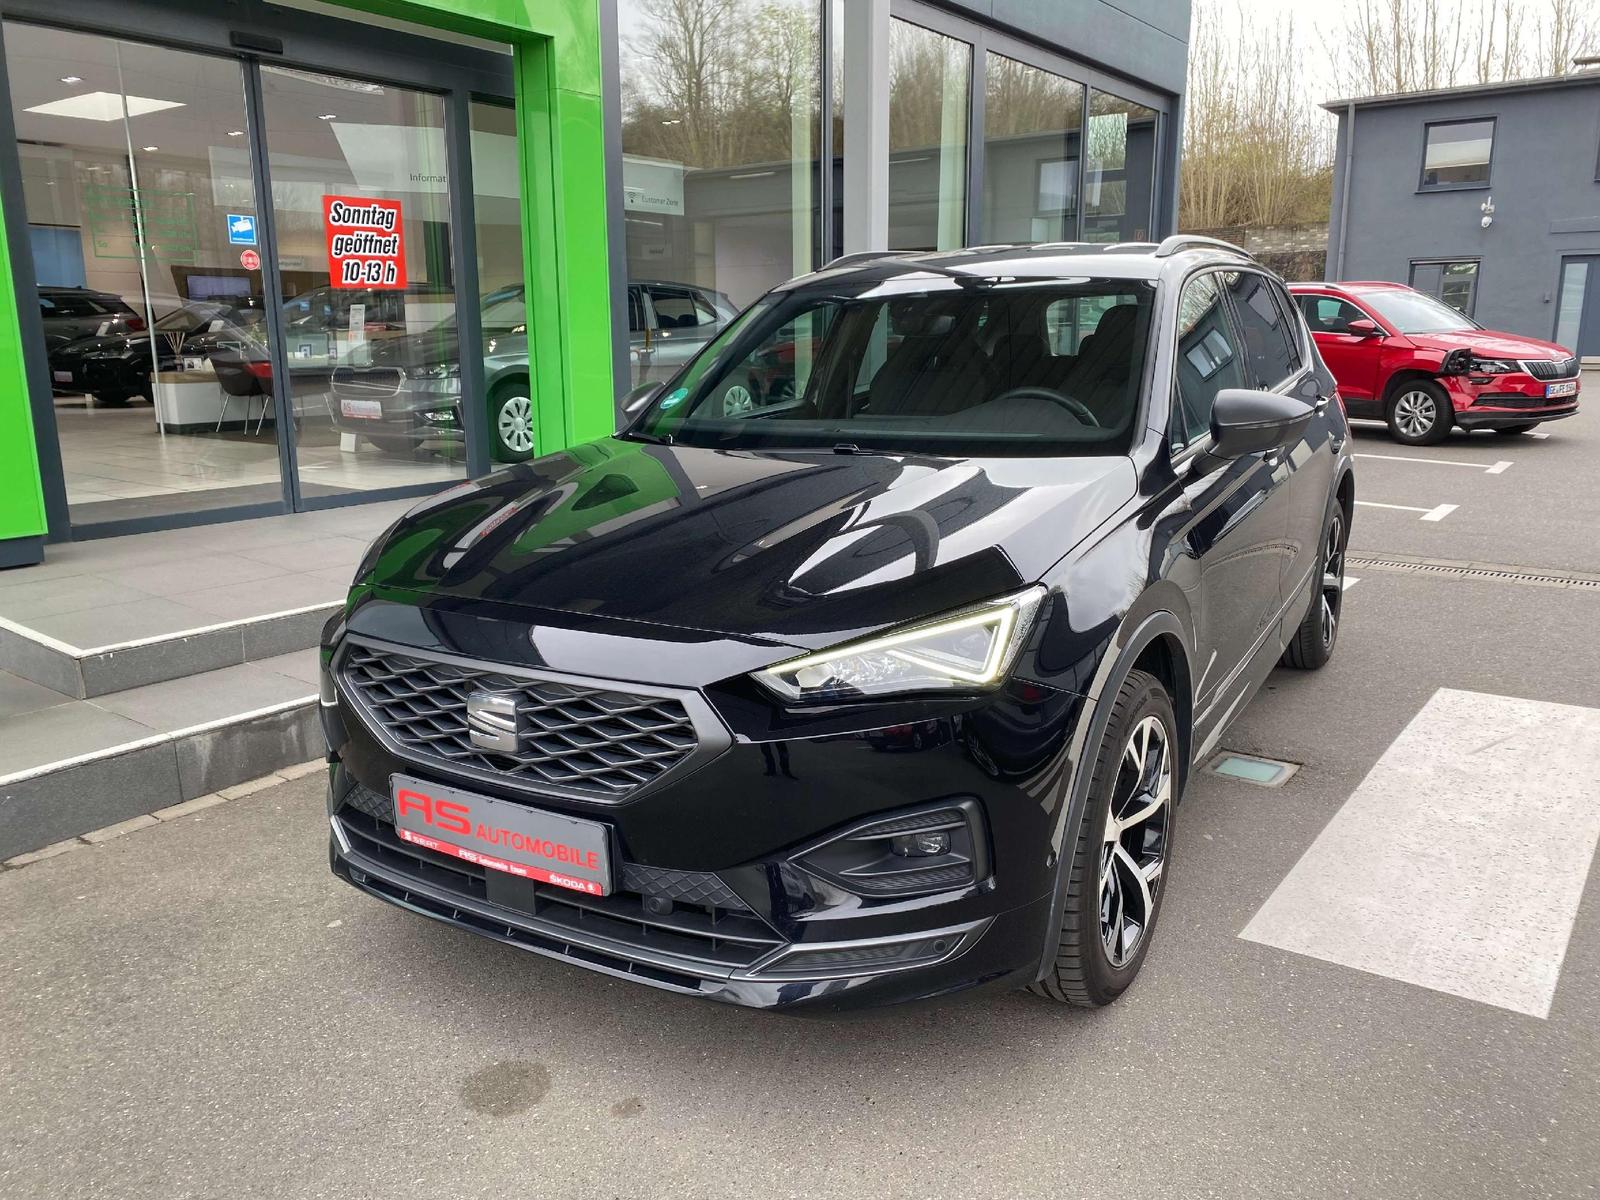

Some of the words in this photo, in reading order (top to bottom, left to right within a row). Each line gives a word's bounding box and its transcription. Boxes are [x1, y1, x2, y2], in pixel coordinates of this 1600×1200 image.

[330, 201, 395, 230] Sonntag
[333, 232, 398, 257] geöffnet
[343, 260, 382, 282] 10-13
[385, 262, 396, 282] h
[397, 789, 472, 835] AS
[475, 822, 600, 871] AUTOMOBILE
[549, 873, 586, 890] ŠKODA
